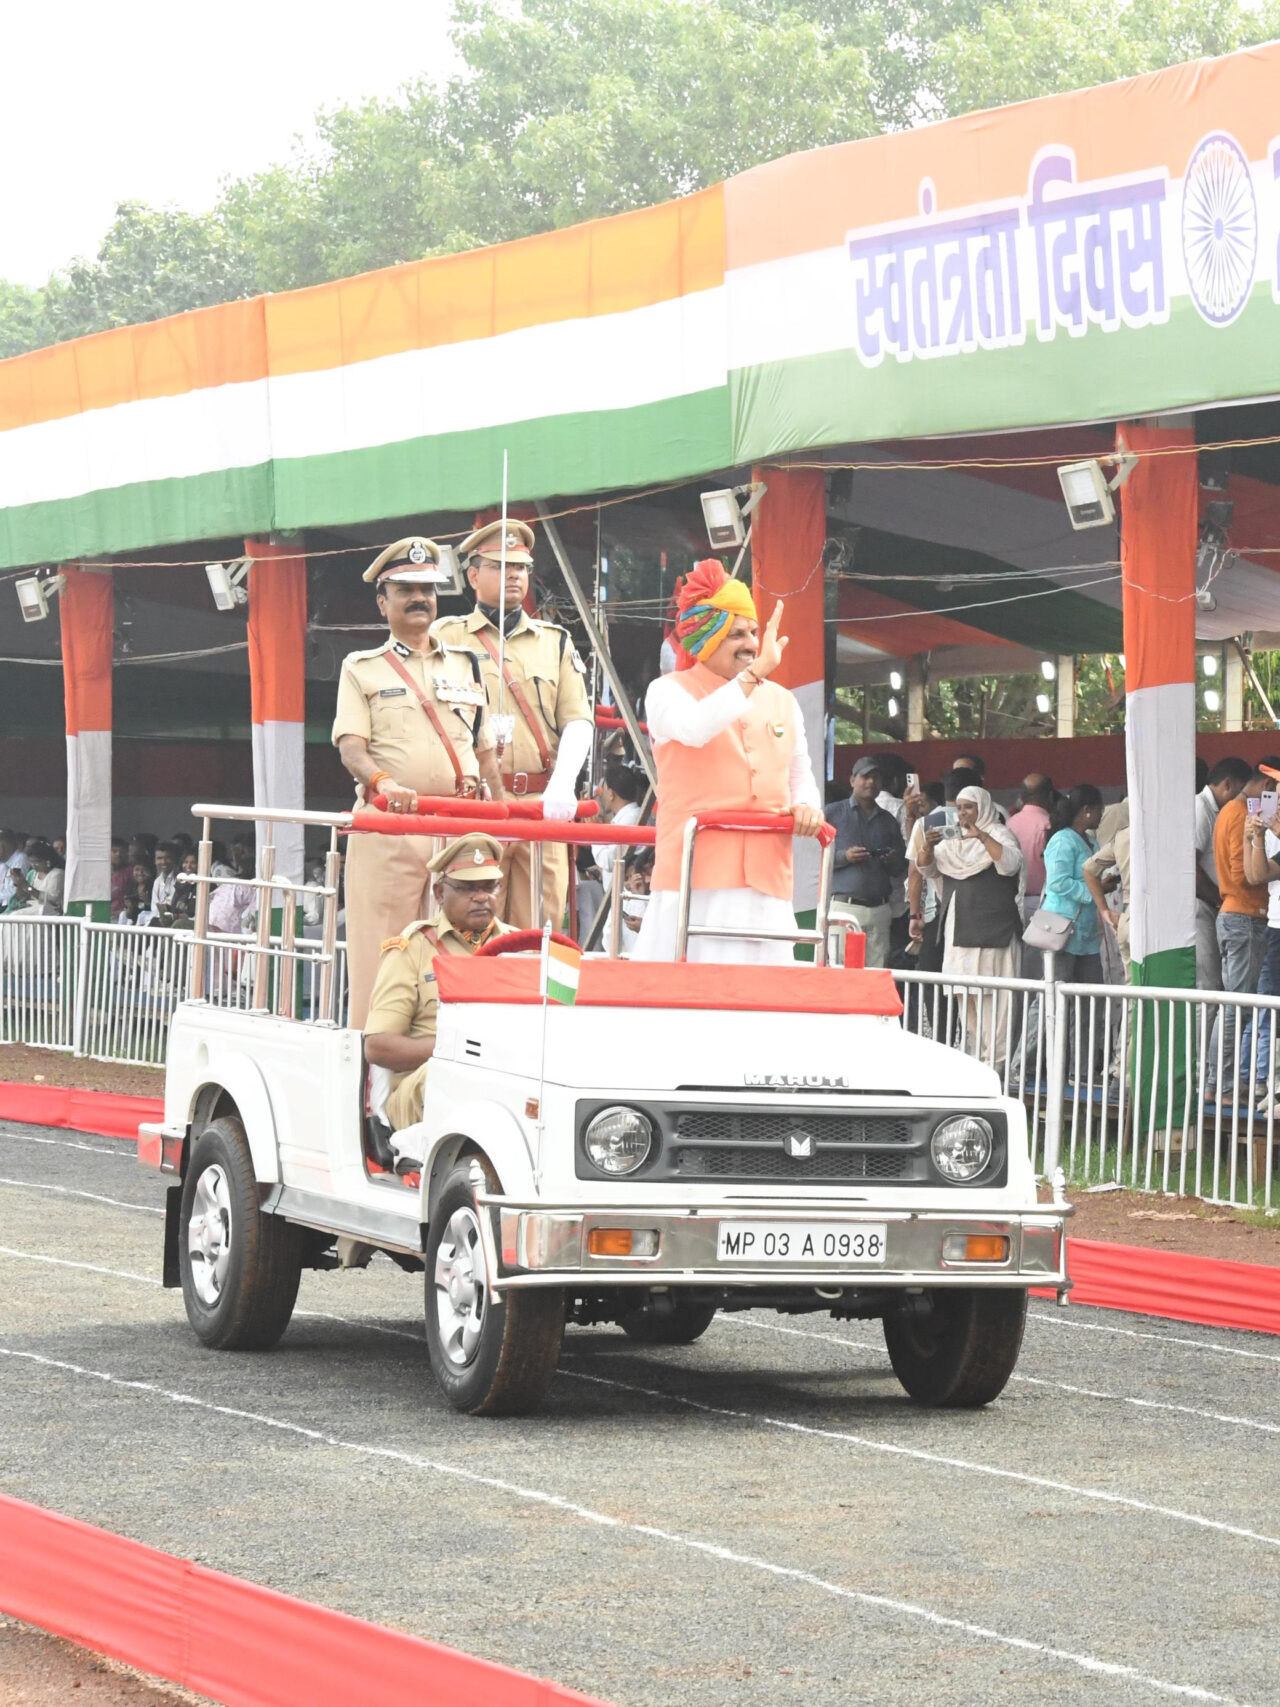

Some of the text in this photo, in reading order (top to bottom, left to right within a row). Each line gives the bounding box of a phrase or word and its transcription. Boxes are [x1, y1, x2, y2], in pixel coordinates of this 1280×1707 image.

[849, 186, 1021, 359] स्वतंत्रता
[1028, 156, 1166, 331] दिवस
[743, 1072, 849, 1088] MARUTI
[725, 1232, 880, 1257] MP 03 A 0938
